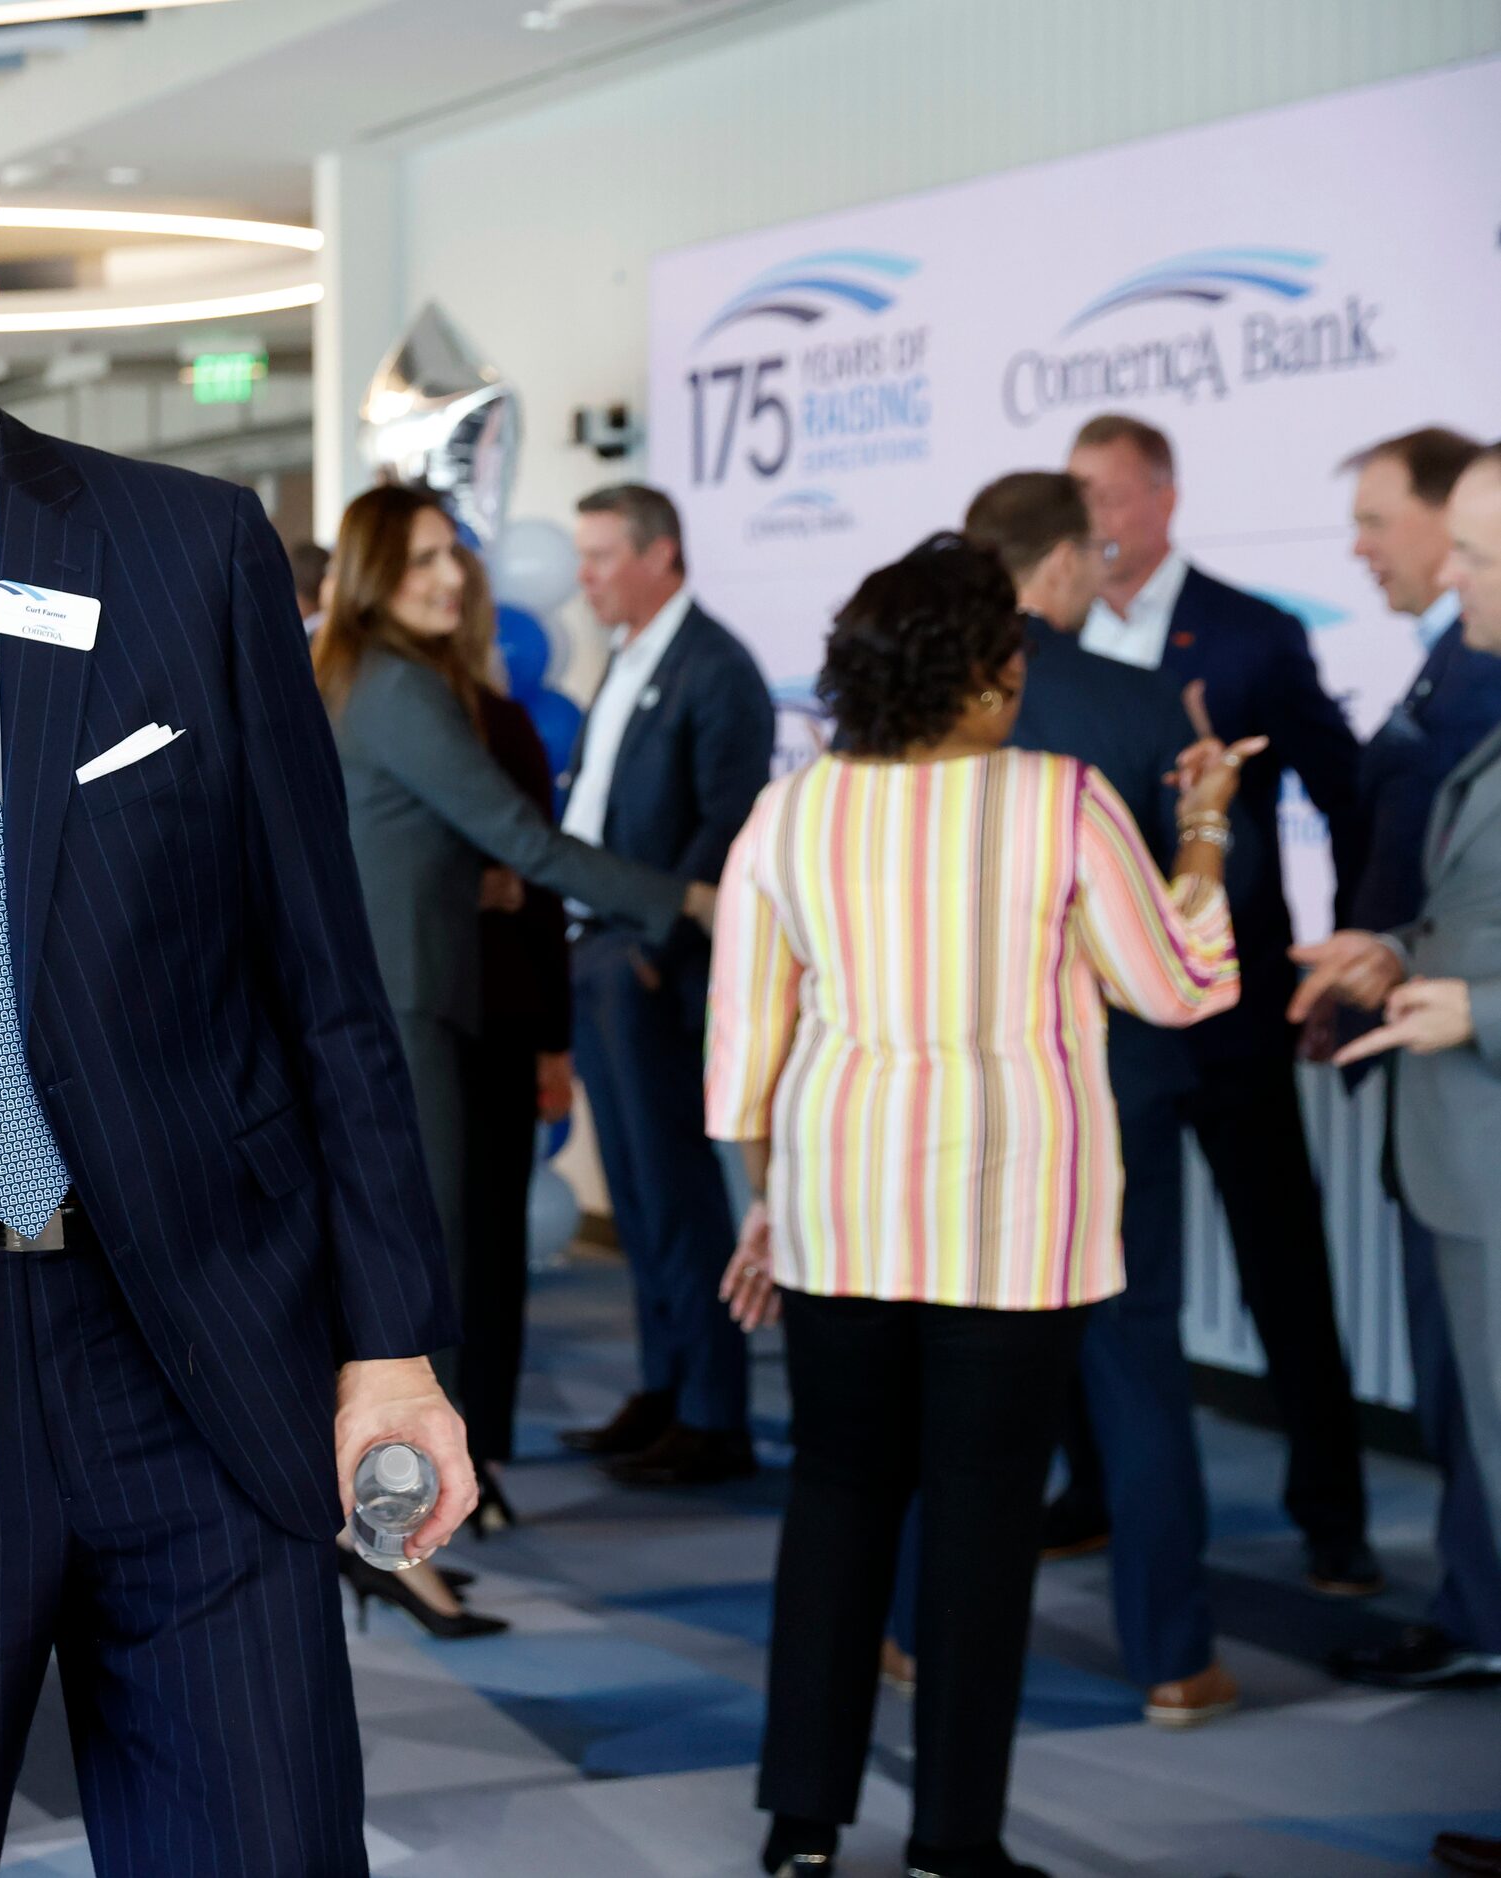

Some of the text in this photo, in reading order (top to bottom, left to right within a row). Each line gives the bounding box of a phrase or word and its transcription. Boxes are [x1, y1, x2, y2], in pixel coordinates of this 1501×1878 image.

[802, 328, 930, 383] YEARS OF
[1243, 294, 1382, 382] Bank
[690, 358, 790, 484] 175
[803, 377, 930, 438] RAISING
[26, 606, 66, 619] Curt Farmer
